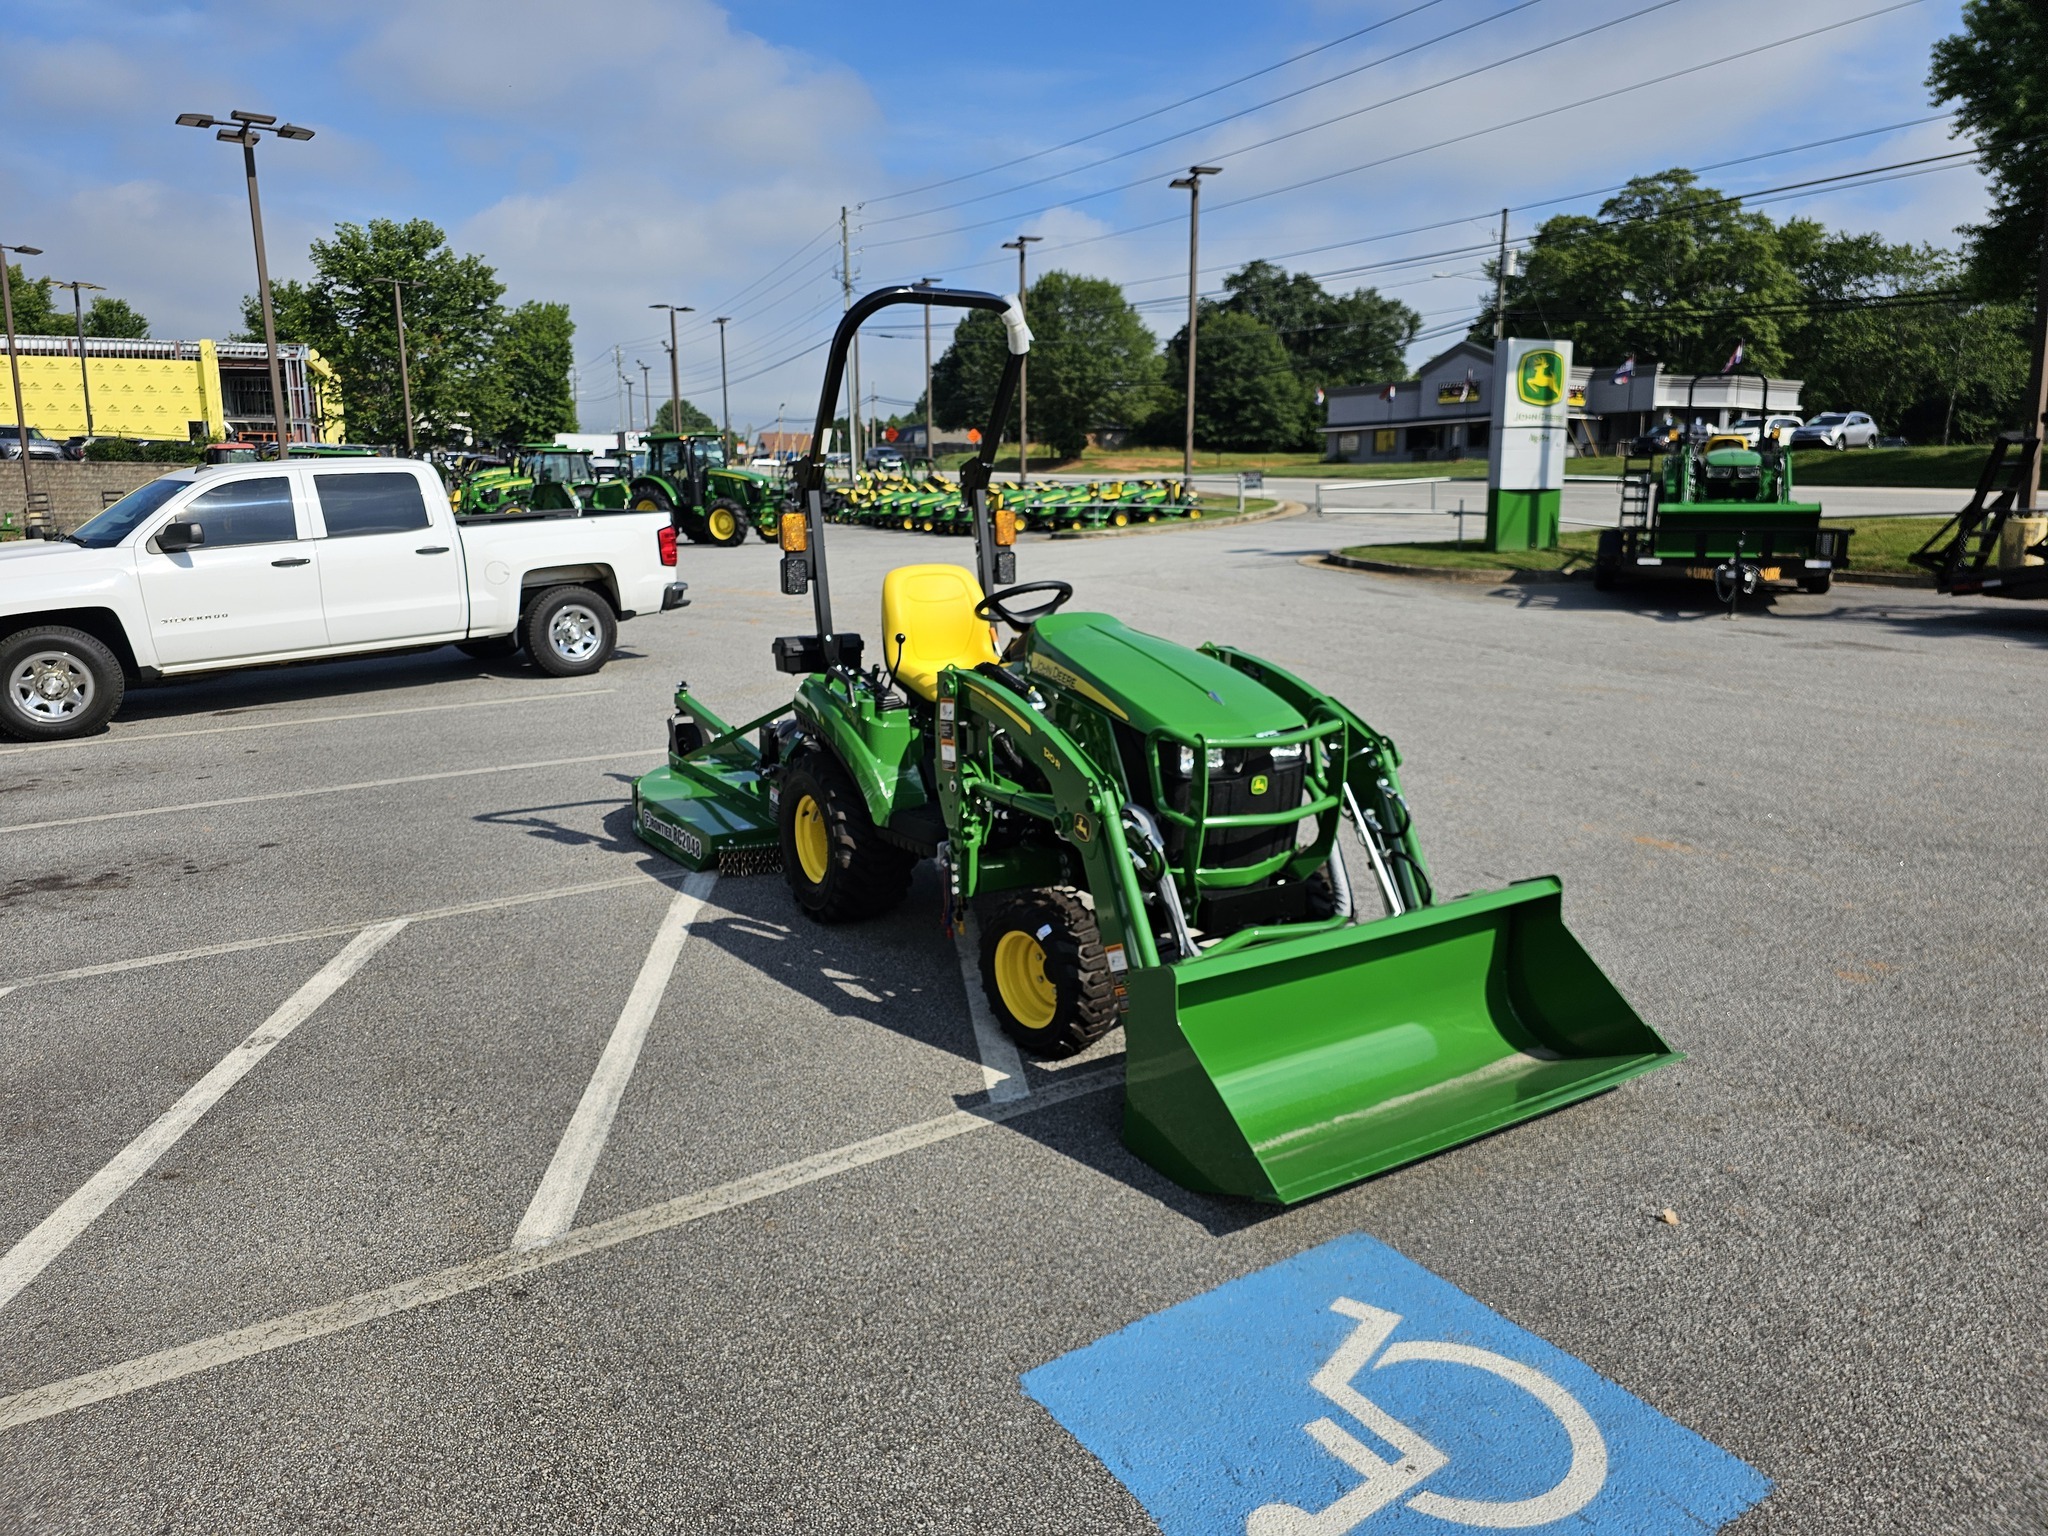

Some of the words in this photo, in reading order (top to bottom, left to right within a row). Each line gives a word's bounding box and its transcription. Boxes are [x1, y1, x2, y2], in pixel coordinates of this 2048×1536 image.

[1034, 661, 1053, 678] JOHN
[1052, 666, 1077, 690] DEERE
[643, 809, 672, 840] FRONTIER
[672, 824, 701, 859] RC2048
